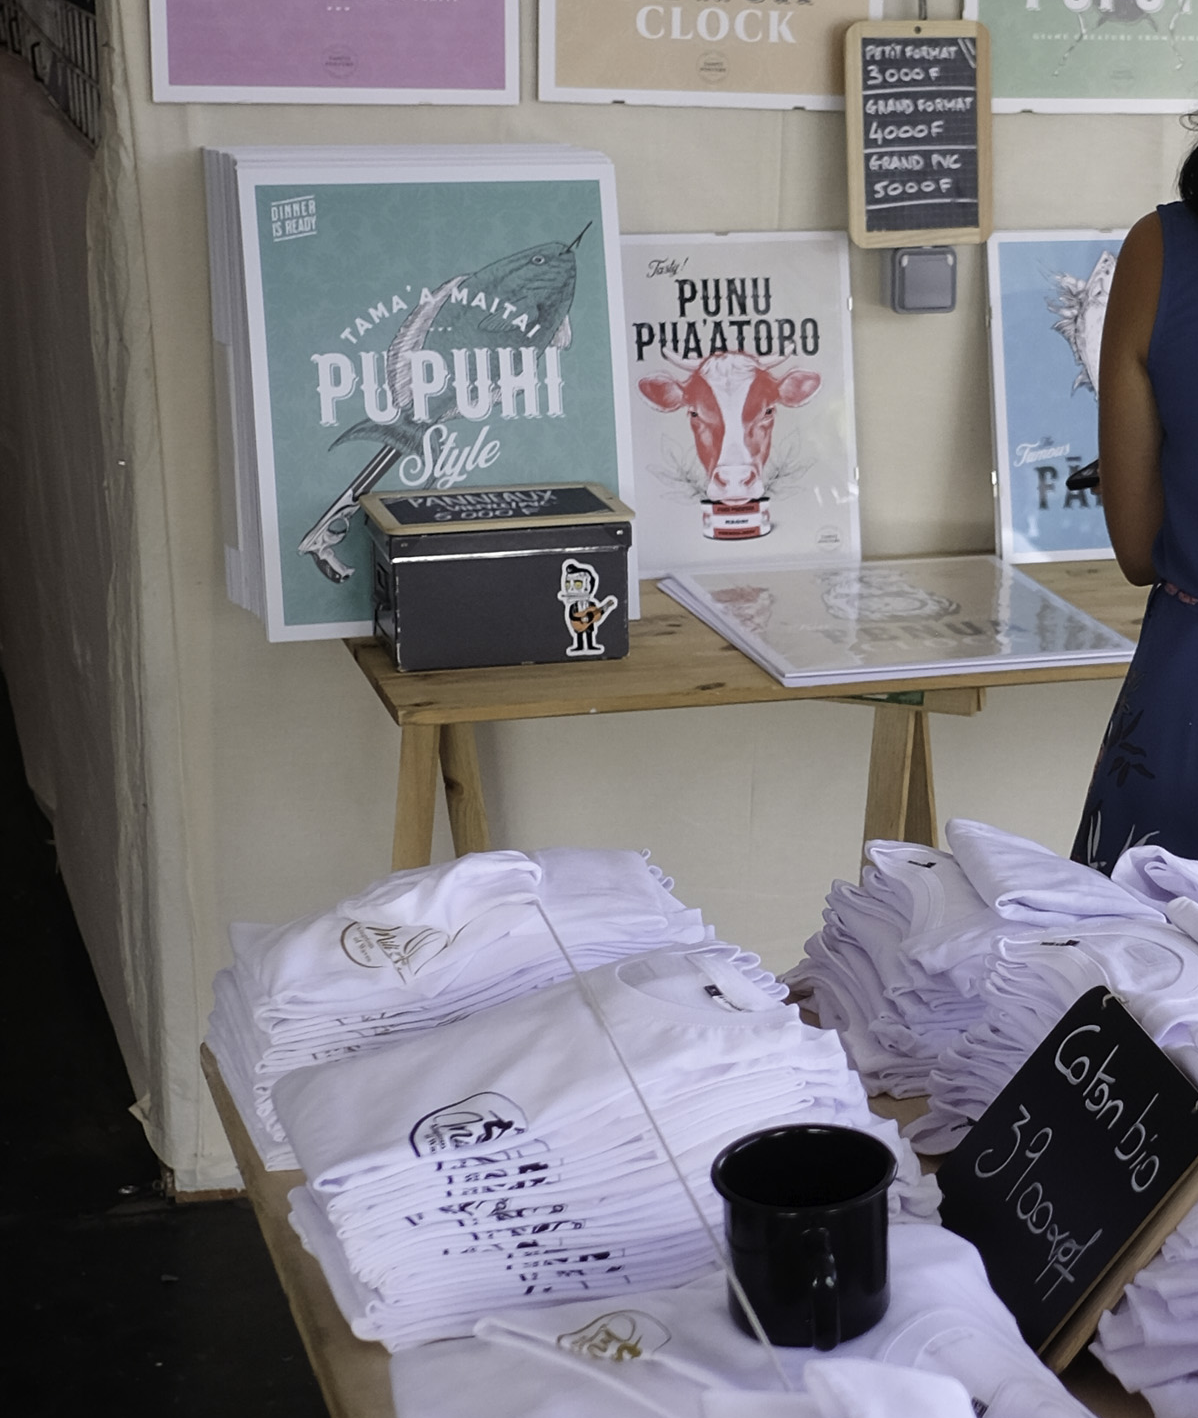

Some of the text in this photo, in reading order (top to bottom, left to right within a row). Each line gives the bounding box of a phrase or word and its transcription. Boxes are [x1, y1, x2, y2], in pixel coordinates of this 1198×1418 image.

[634, 5, 798, 44] CLOCK
[905, 45, 959, 61] FORMAT
[865, 96, 974, 115] GRAND FORMAT
[869, 153, 962, 171] GRAND PVC
[270, 200, 317, 221] DINNER
[272, 214, 318, 237] IS READY
[646, 256, 689, 278] Tasty!
[450, 284, 543, 340] MAITAI
[676, 277, 772, 316] PUNU
[311, 346, 568, 429] PUPUHI
[399, 423, 502, 488] Style
[1114, 1093, 1160, 1193] bio
